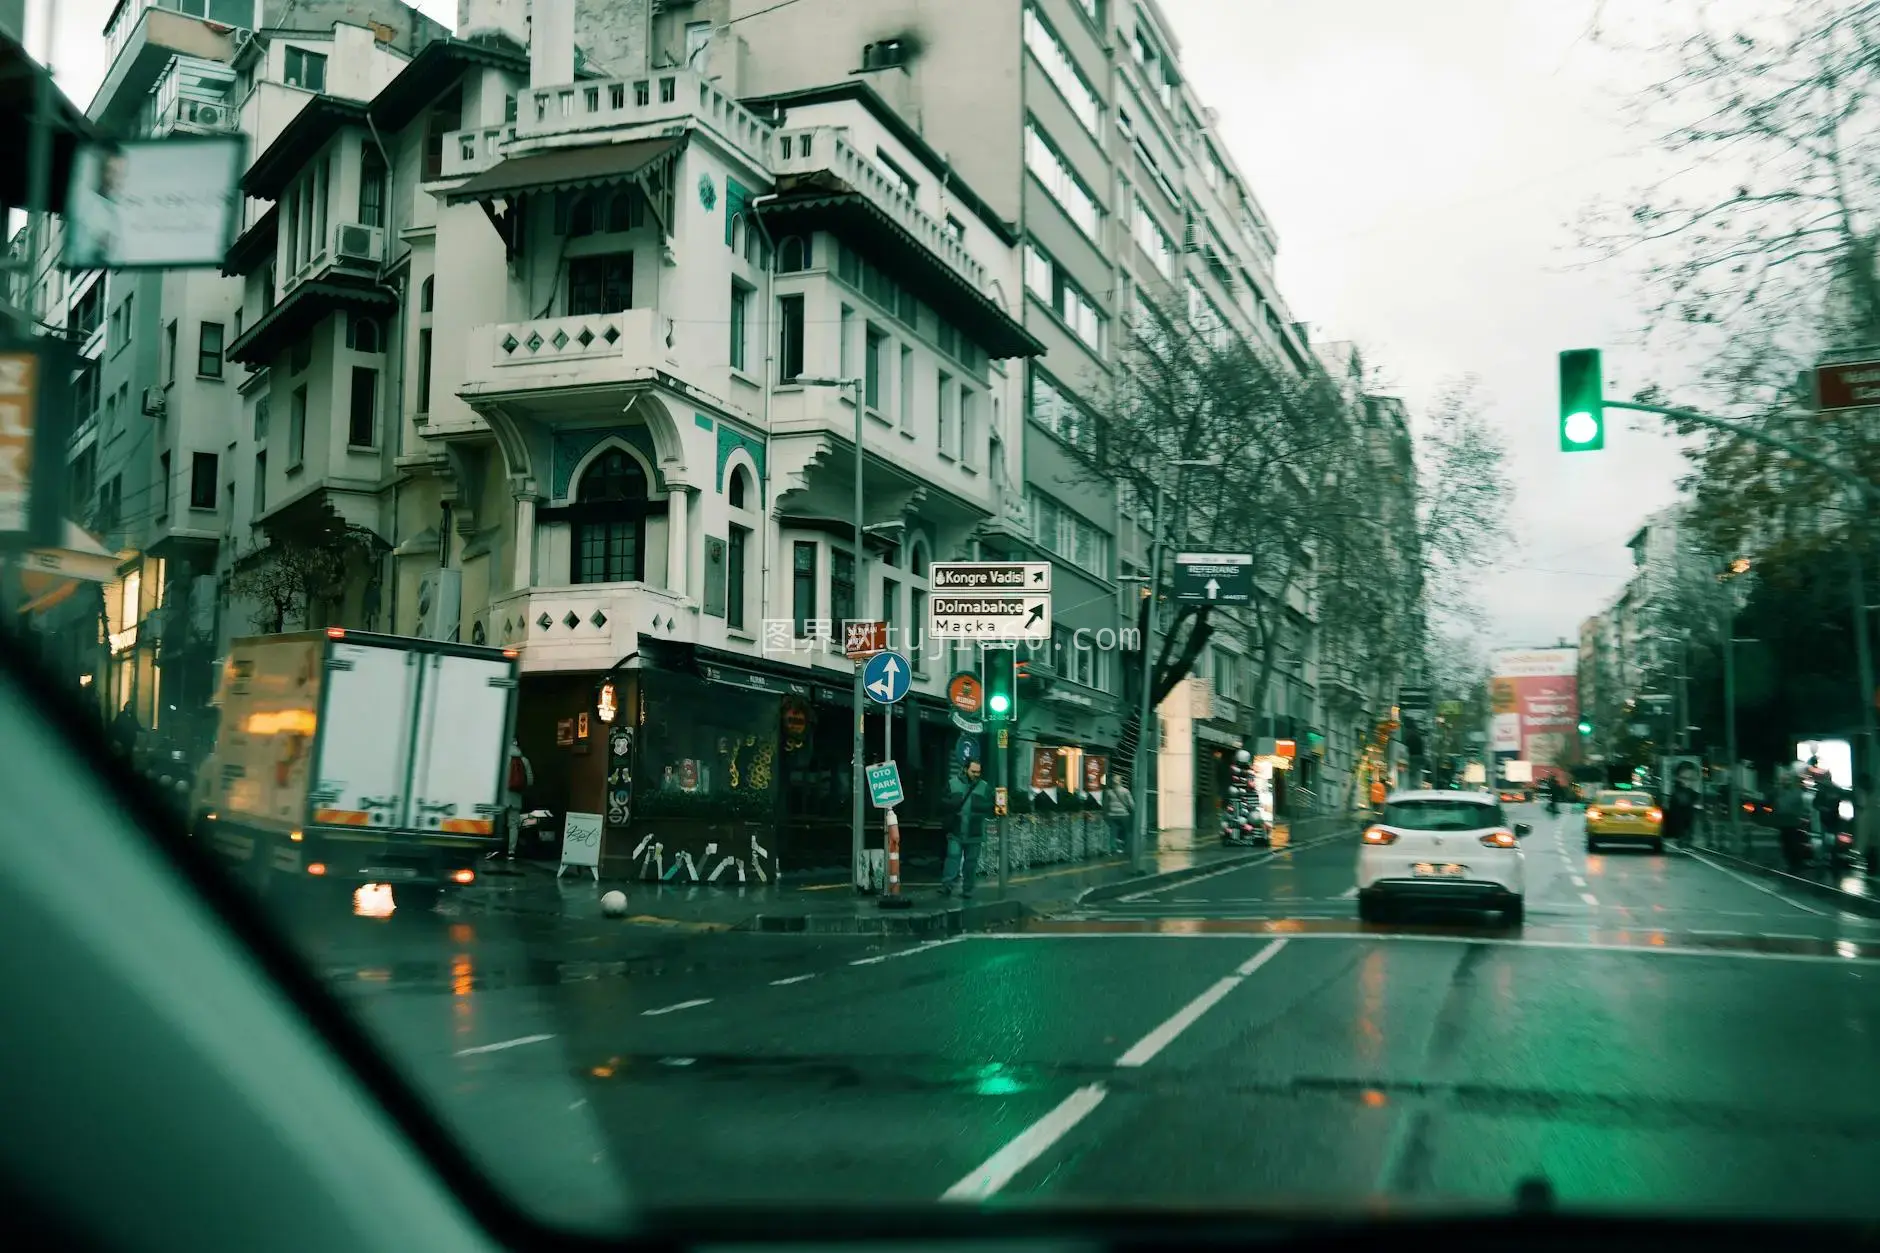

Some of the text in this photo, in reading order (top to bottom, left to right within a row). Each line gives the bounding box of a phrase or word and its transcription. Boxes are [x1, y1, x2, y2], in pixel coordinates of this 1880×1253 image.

[945, 570, 1024, 586] Kongre Vadisi
[935, 600, 1024, 615] Dolmabahçe
[936, 619, 996, 634] Maçka
[872, 768, 891, 779] OTO
[872, 778, 897, 791] PARK
